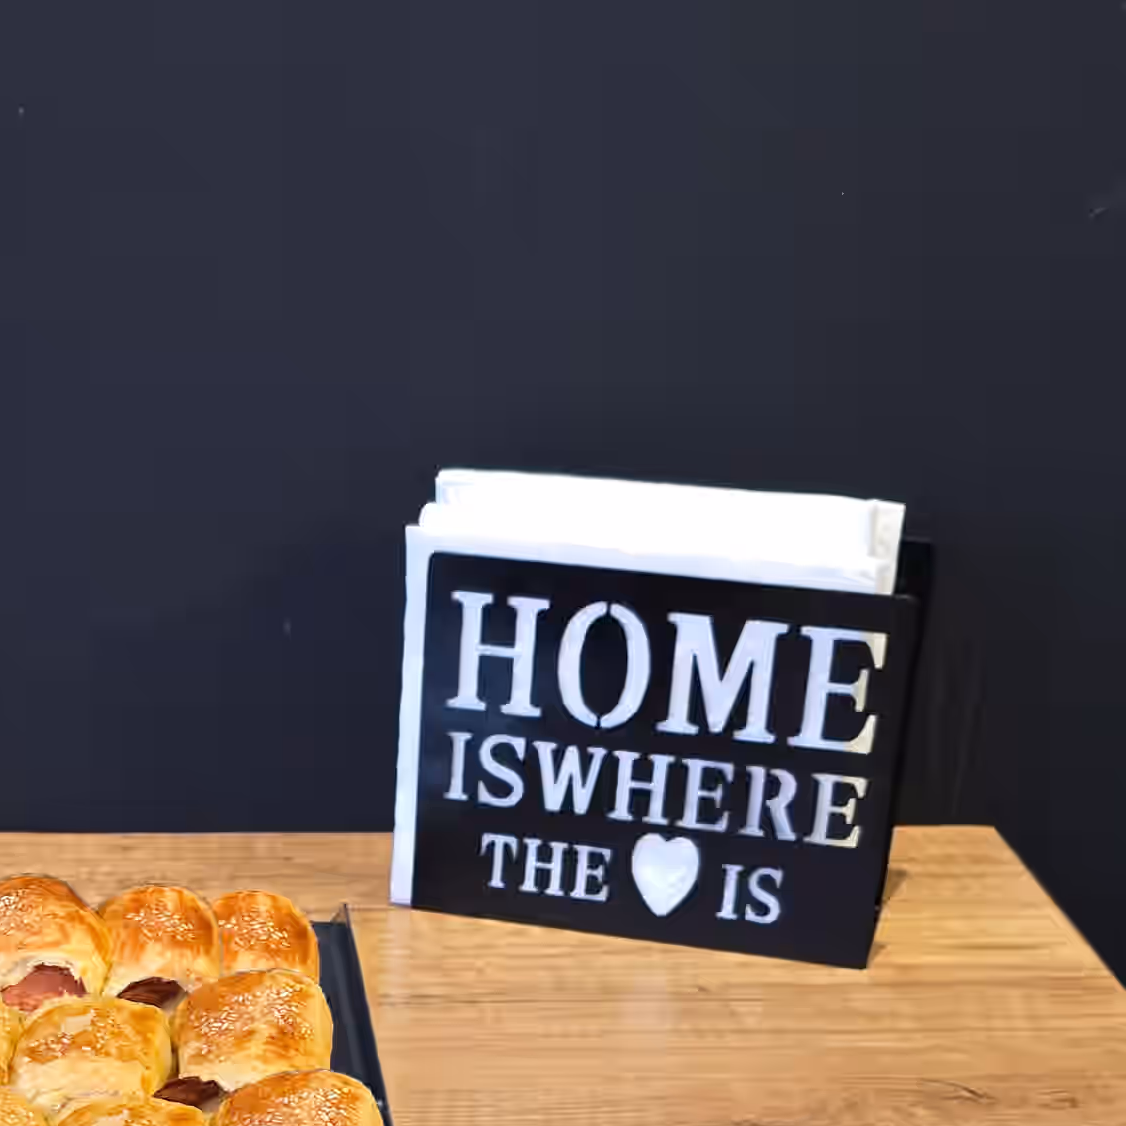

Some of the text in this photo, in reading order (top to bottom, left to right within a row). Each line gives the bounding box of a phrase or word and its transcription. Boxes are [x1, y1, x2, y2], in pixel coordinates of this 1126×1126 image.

[446, 590, 888, 755] HOME
[480, 833, 783, 924] THE IS
